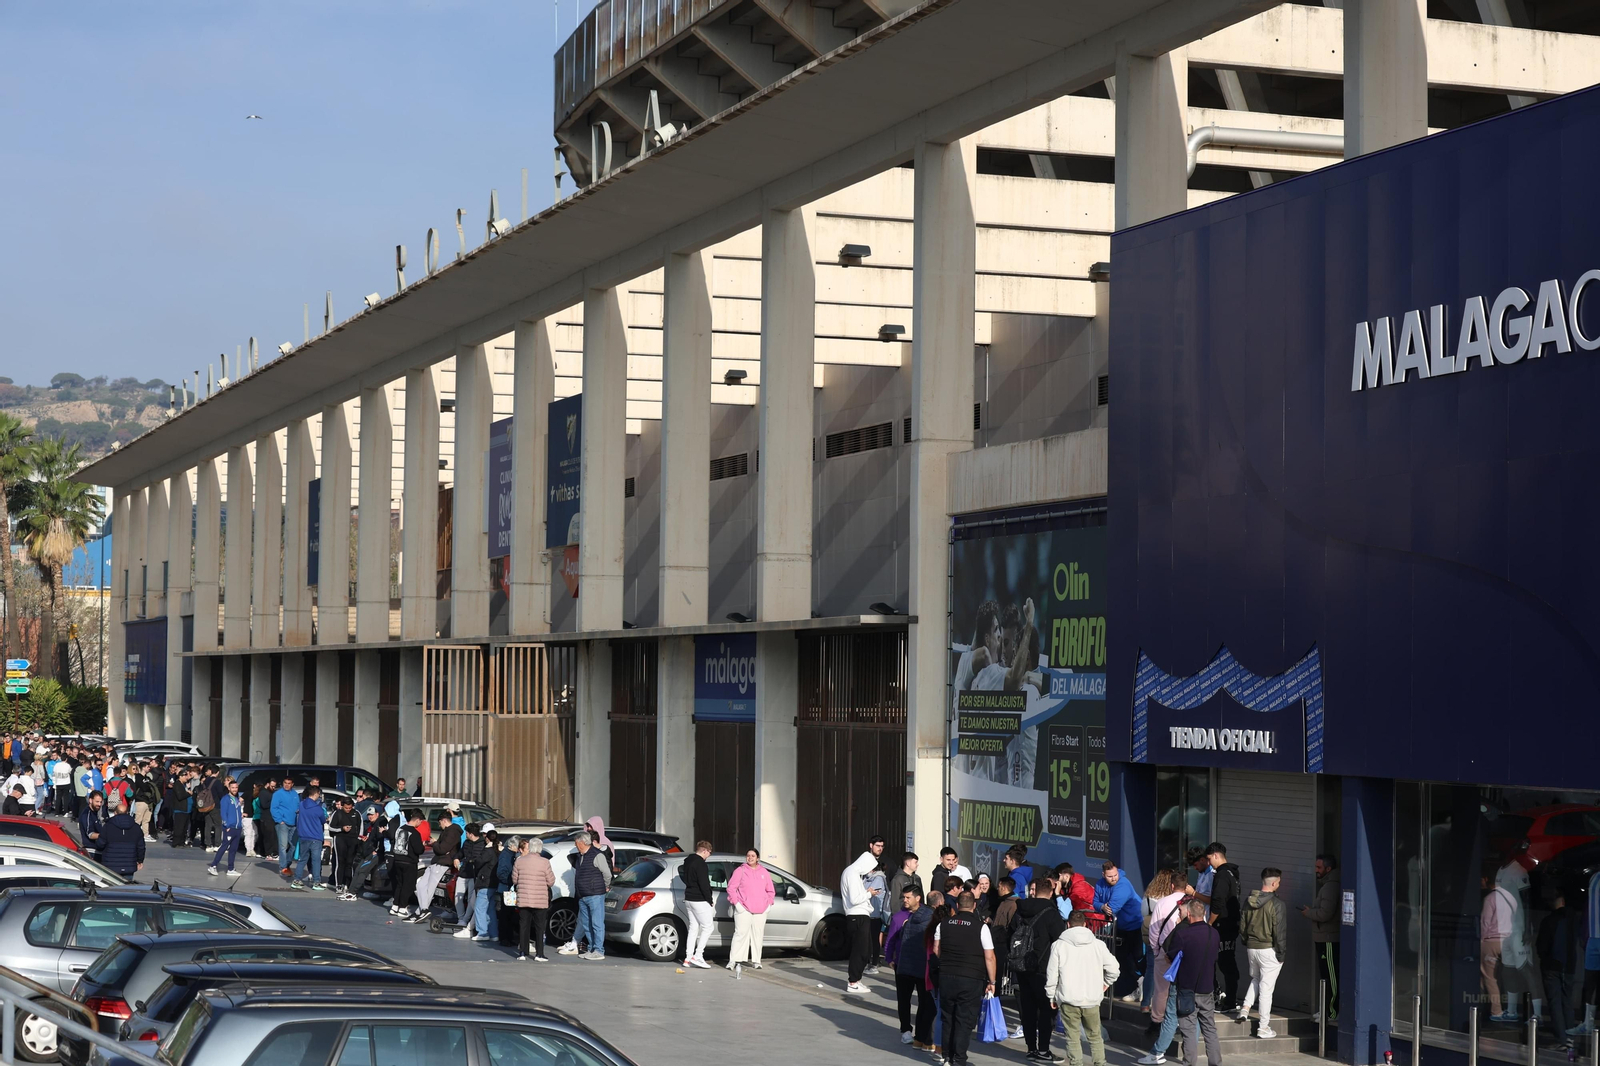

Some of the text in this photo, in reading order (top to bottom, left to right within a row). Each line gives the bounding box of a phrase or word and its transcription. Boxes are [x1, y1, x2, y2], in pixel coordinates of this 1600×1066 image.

[1053, 562, 1089, 601] Olin
[1051, 616, 1106, 666] FOROFO
[1052, 678, 1068, 695] DEL
[960, 696, 1026, 710] POR SER MALAGUISTA,
[960, 717, 1018, 730] TE DAMOS NUESTRA
[960, 738, 1003, 752] MEJOR OFERTA
[1052, 734, 1079, 746] Fibra Start
[1088, 736, 1102, 747] Todo
[1169, 726, 1273, 754] TIENDA OFICIAL
[1050, 759, 1071, 799] 15
[1088, 762, 1110, 802] 19
[974, 804, 992, 838] POR
[992, 805, 1036, 842] USTEDES!
[1050, 814, 1070, 827] 300Mb
[1090, 818, 1109, 831] 300Mb
[1089, 840, 1104, 852] 20GB
[1463, 991, 1508, 1003] humme
